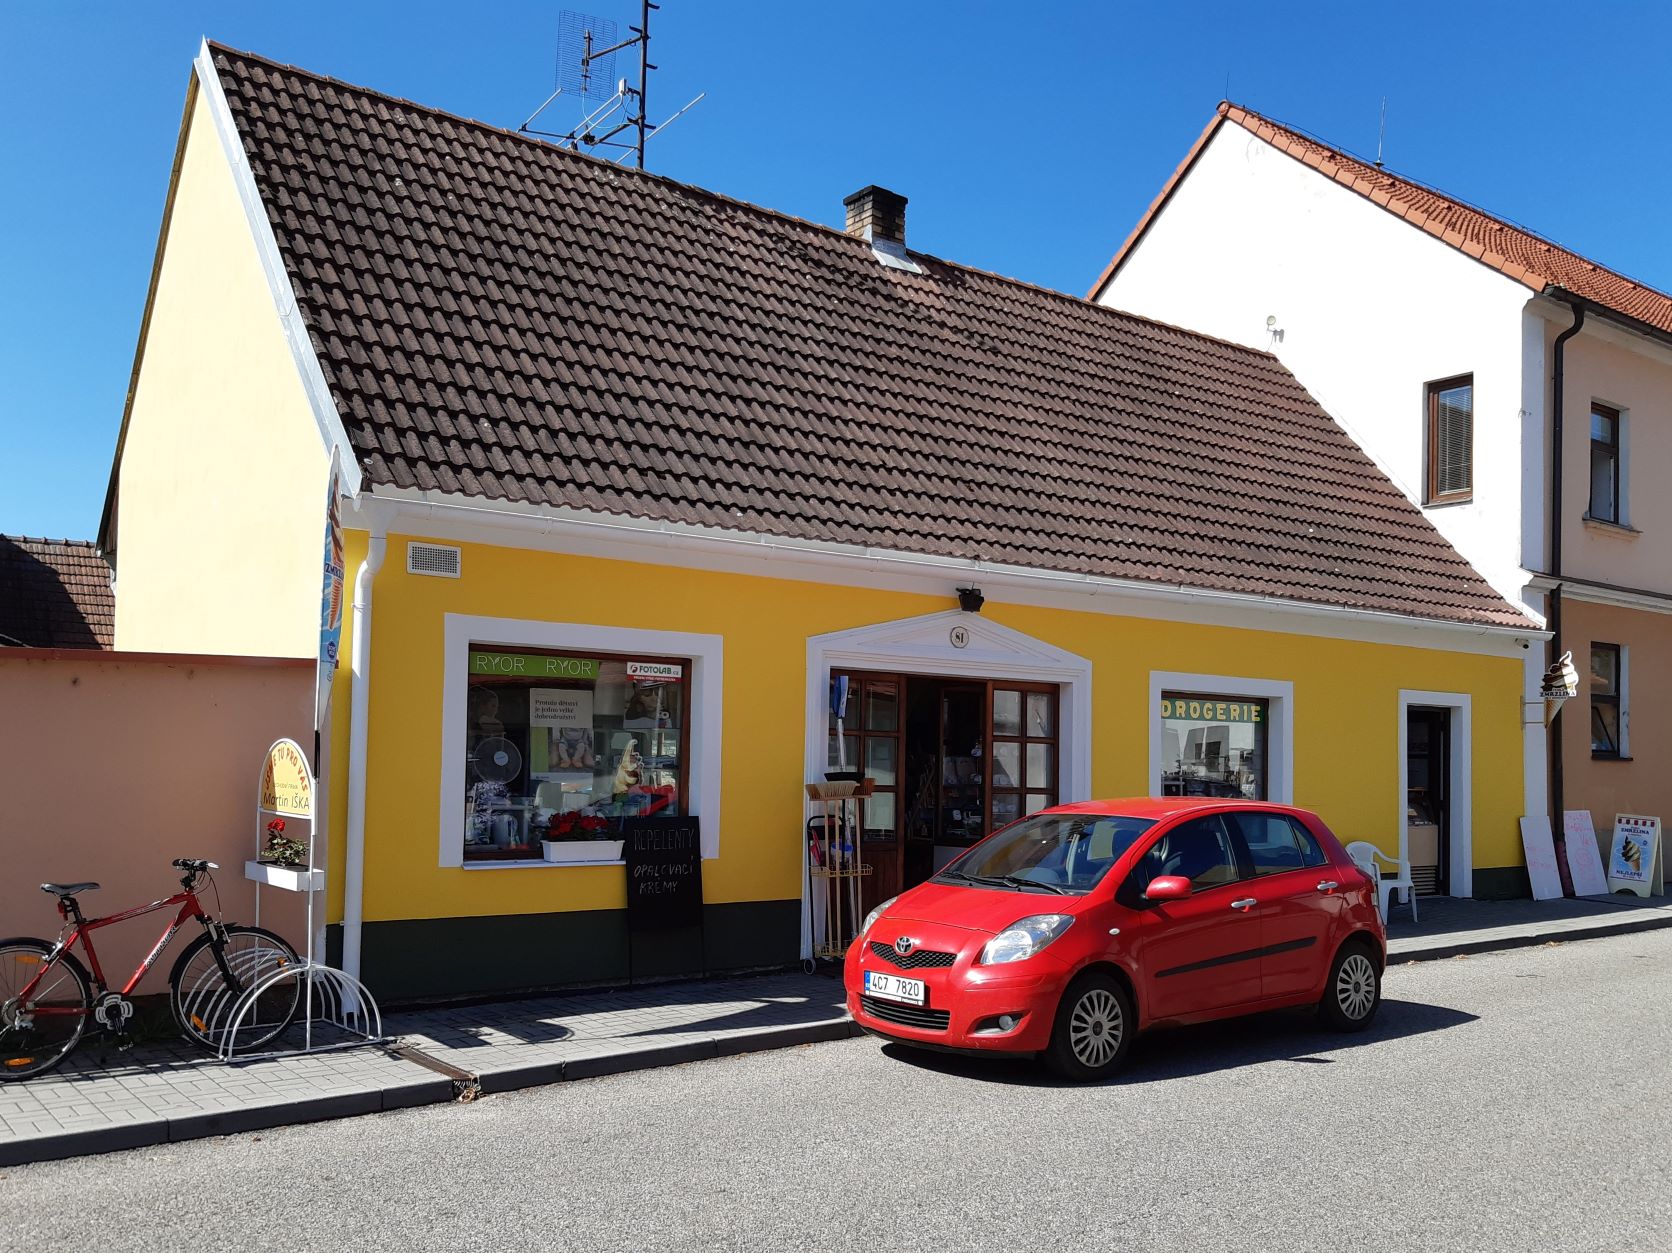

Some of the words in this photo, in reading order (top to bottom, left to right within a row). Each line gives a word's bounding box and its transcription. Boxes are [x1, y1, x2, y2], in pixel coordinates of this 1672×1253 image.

[476, 655, 526, 672] RYOR
[546, 659, 593, 676] RYOR
[1161, 699, 1261, 722] DROGERIE
[277, 747, 284, 762] TU
[286, 747, 298, 768] PRO
[263, 792, 289, 807] Martin
[292, 793, 310, 809] IŠKA
[633, 828, 694, 851] REPELENTY
[872, 976, 889, 991] 4C7
[896, 979, 920, 997] 7820
